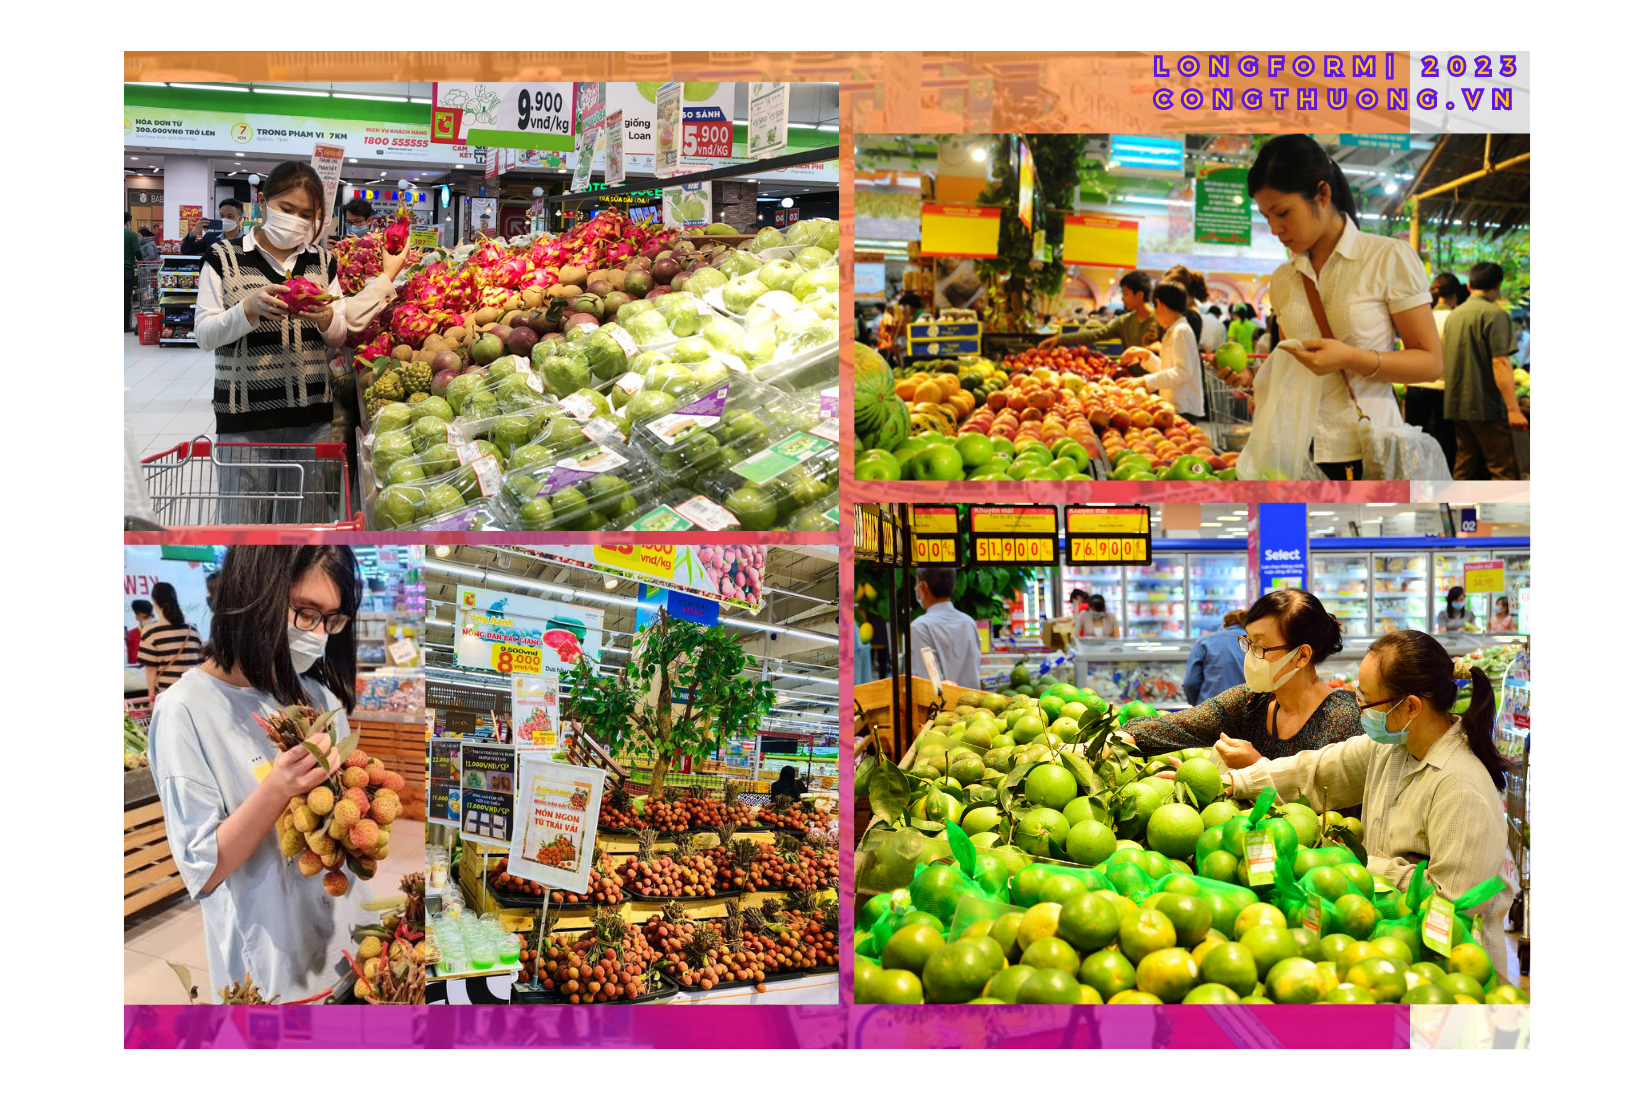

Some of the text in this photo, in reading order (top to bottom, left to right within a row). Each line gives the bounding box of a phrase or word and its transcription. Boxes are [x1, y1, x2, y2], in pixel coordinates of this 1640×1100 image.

[518, 88, 562, 130] 9.900
[695, 110, 720, 118] SÁNH
[530, 115, 569, 134] vnđ/kg
[624, 118, 650, 129] giống
[240, 126, 247, 134] 7
[289, 130, 313, 139] PHẠM
[628, 132, 651, 140] Loan
[364, 137, 428, 148] 1800 555555
[698, 145, 728, 156] vnđ/KG
[354, 190, 380, 200] KIDS
[1462, 521, 1476, 532] 02
[980, 542, 1038, 556] 51.900
[1074, 542, 1132, 556] 76.900
[1264, 549, 1301, 560] Select
[641, 554, 671, 570] vnd/kg
[498, 652, 540, 673] 8.000
[514, 664, 539, 672] vnd/kg
[535, 808, 580, 823] MÓN NGON
[546, 819, 562, 830] TRÁI
[564, 822, 578, 833] VẢI
[1247, 835, 1268, 843] Select
